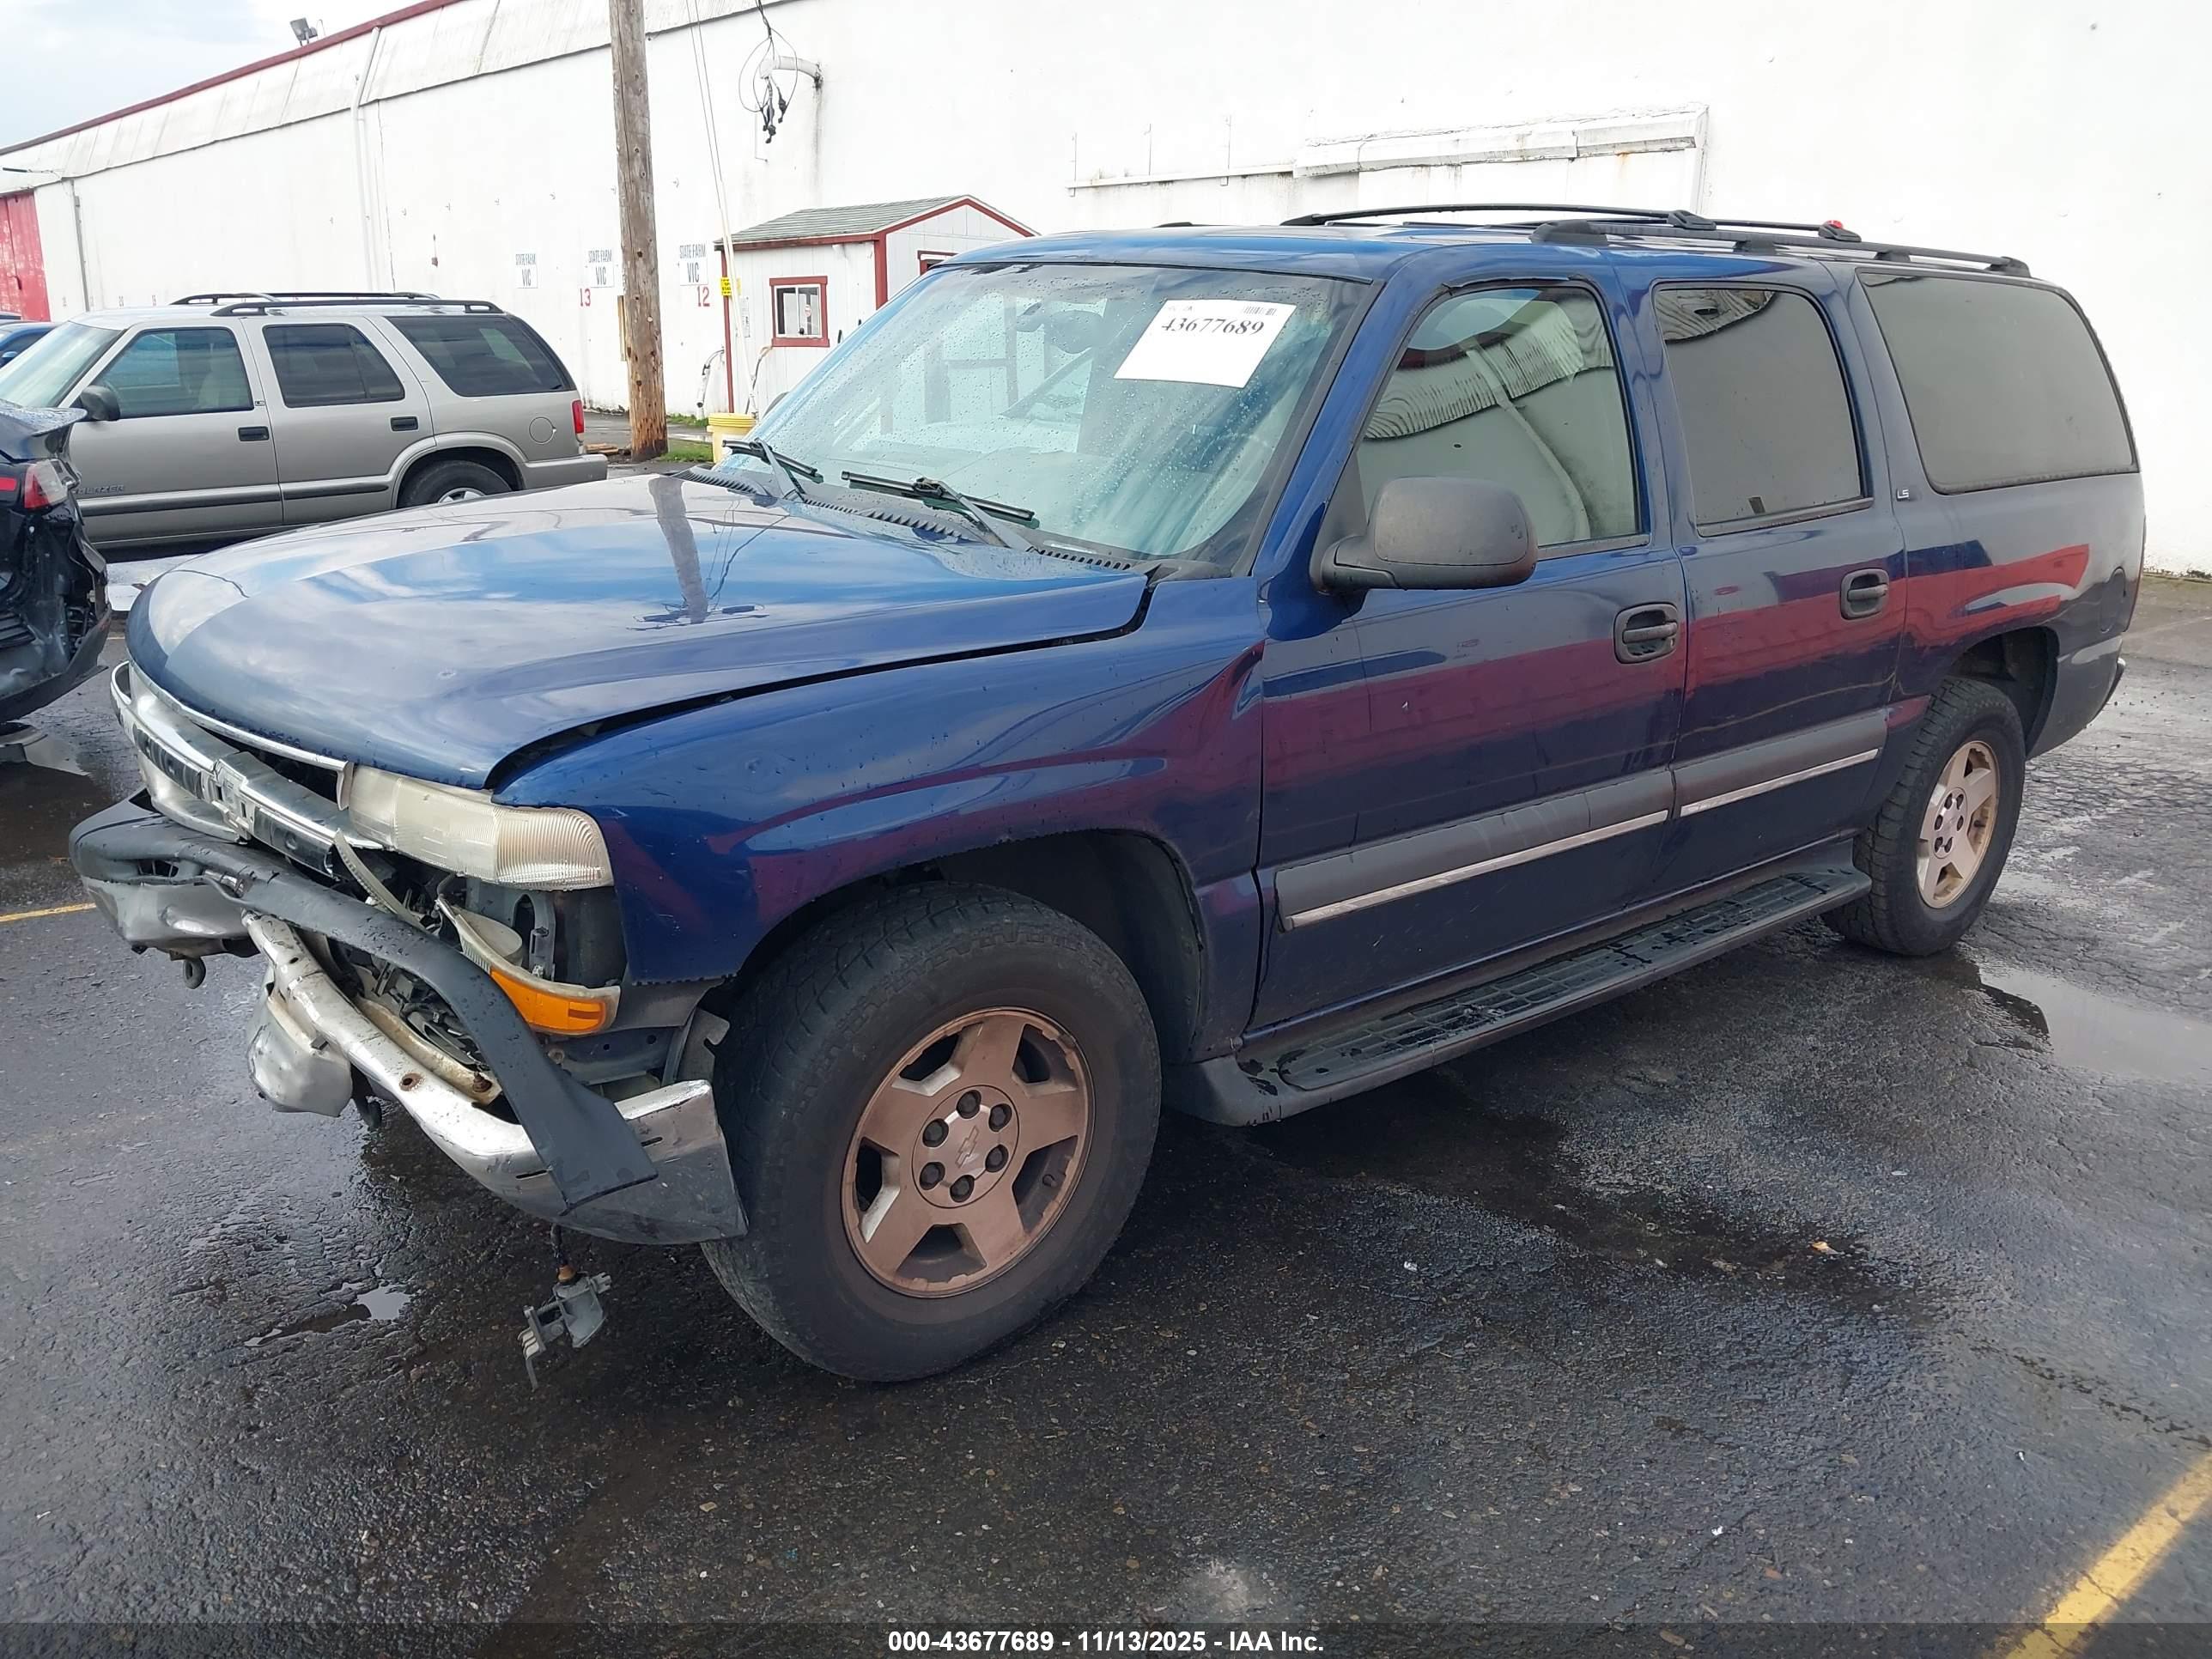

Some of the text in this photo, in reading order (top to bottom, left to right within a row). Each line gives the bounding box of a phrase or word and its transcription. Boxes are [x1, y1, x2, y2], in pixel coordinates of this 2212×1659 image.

[588, 250, 600, 264] STATE
[680, 244, 706, 259] STATE FARM
[521, 269, 532, 286] VIC
[595, 266, 607, 285] VIC
[687, 262, 700, 283] VIC
[580, 288, 592, 307] 13
[697, 286, 710, 307] 12
[1162, 318, 1265, 335] 43677689
[1897, 489, 1910, 499] LS
